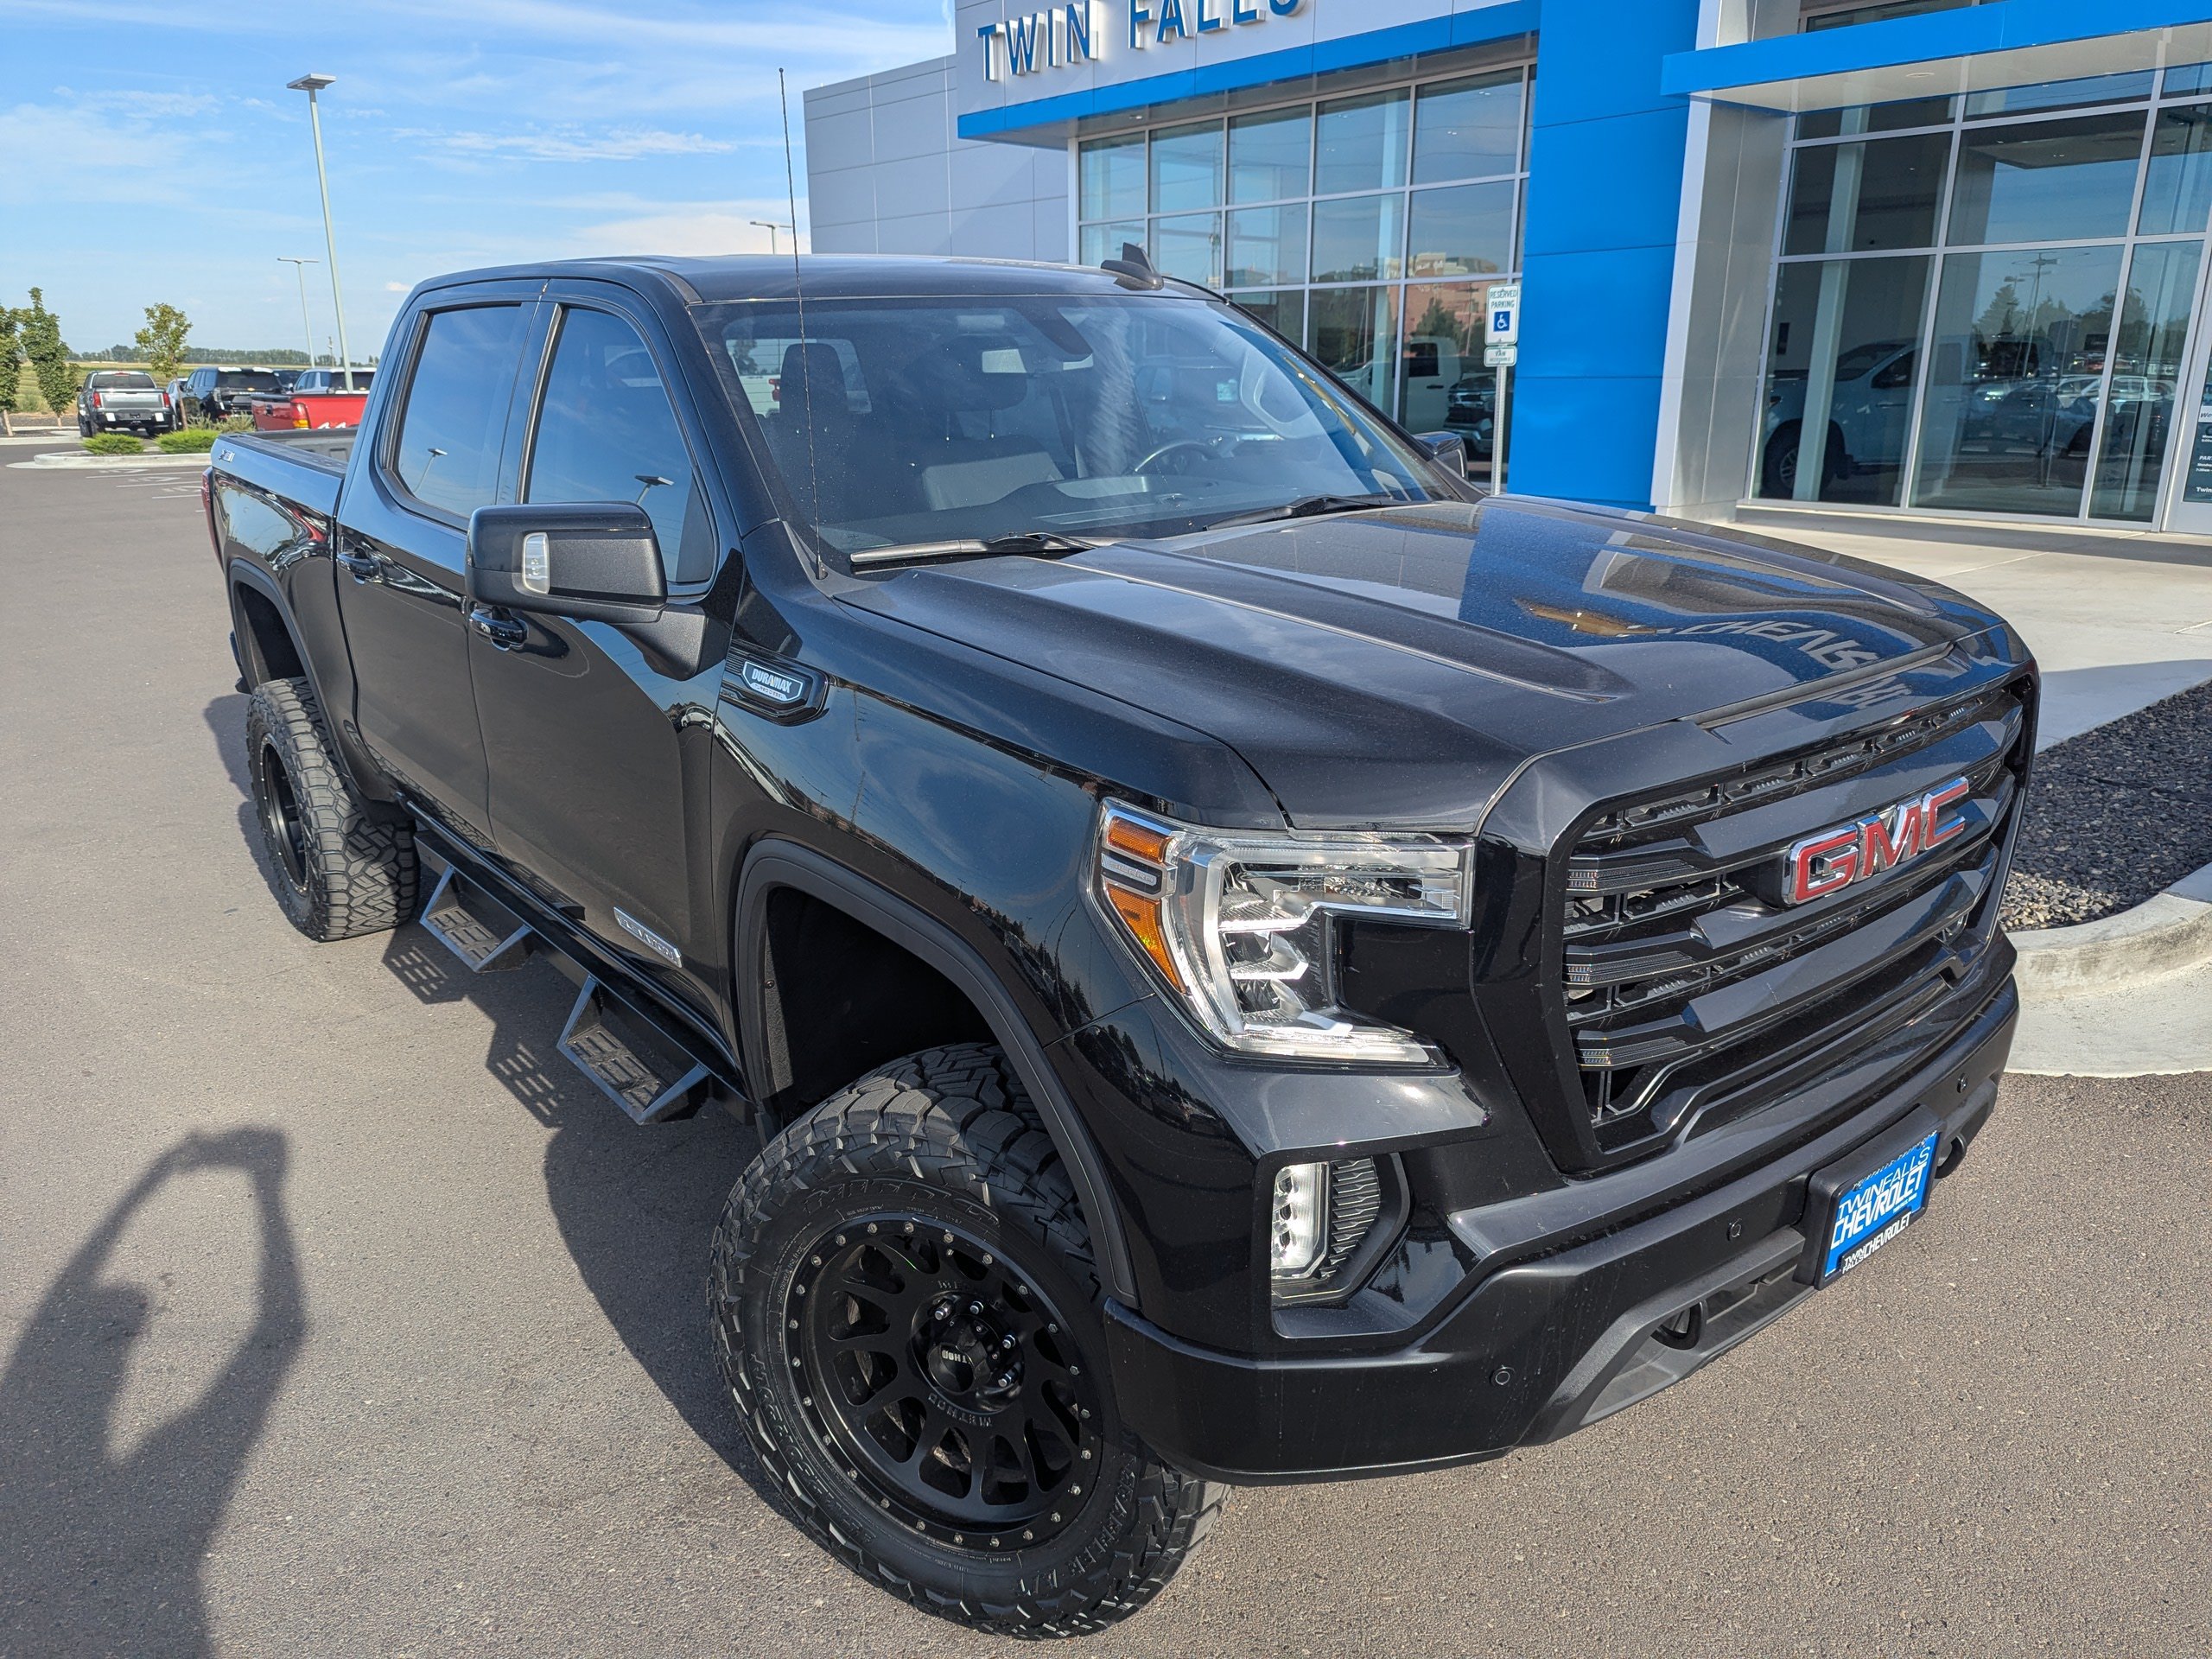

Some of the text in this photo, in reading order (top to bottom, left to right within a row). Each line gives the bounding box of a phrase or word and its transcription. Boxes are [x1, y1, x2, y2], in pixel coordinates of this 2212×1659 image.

[976, 0, 1303, 81] TWIN FAL
[1489, 290, 1517, 299] RESERVED
[752, 668, 792, 693] DURAMAX
[1782, 776, 1969, 906] GMC
[1830, 1162, 1928, 1249] CHEVROLET
[1864, 1211, 1912, 1259] CHEVROLET
[1842, 1255, 1865, 1274] FALLS
